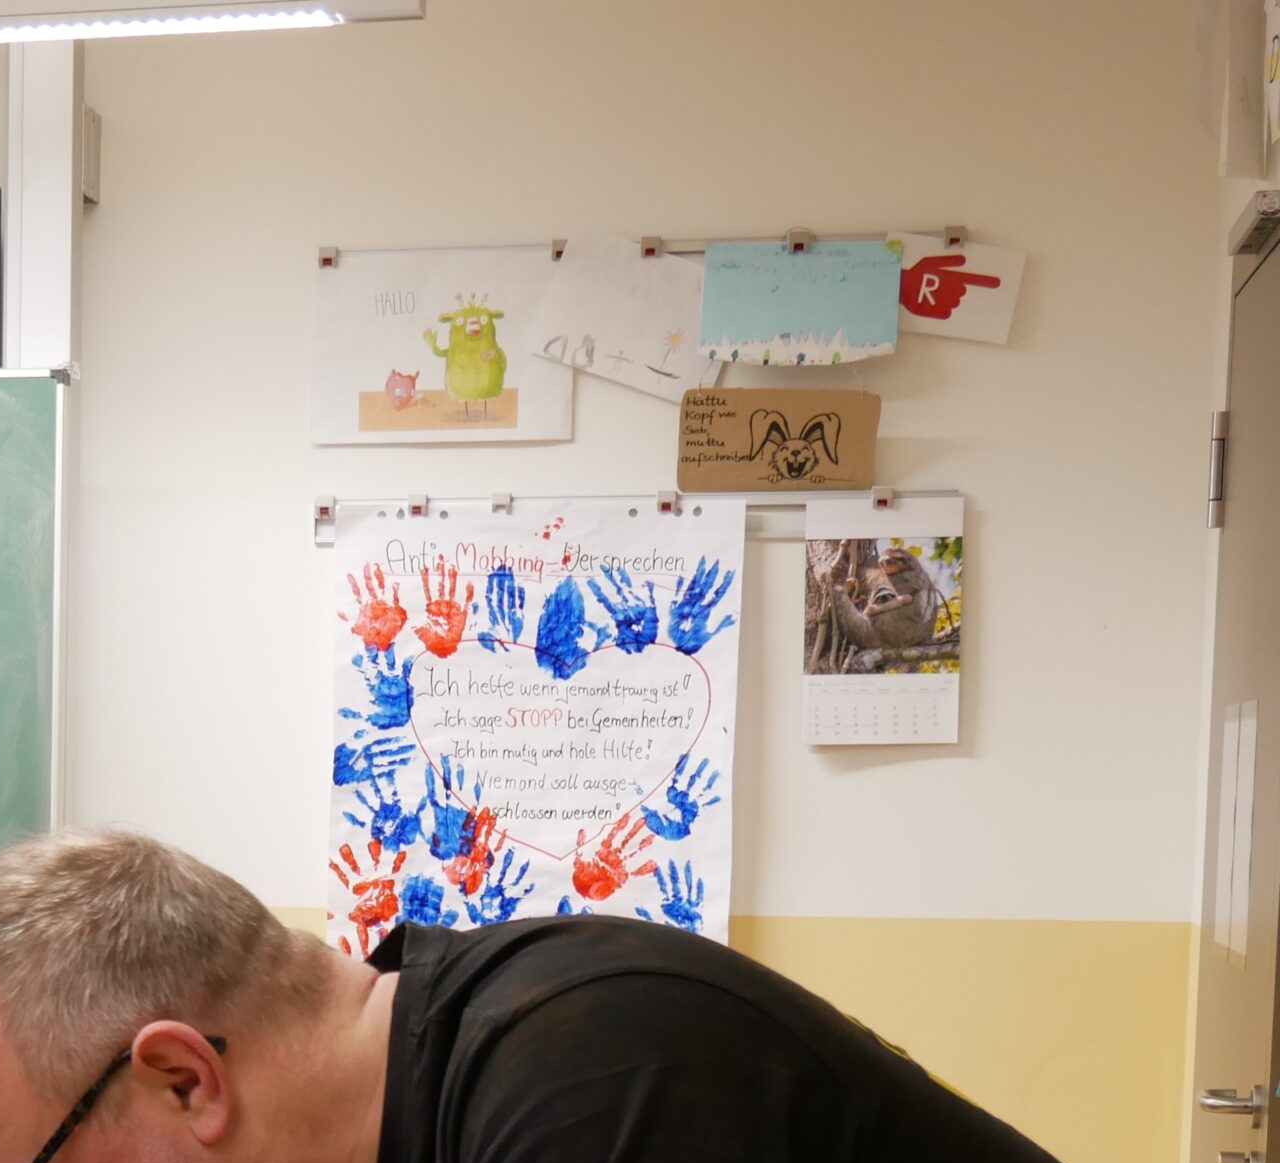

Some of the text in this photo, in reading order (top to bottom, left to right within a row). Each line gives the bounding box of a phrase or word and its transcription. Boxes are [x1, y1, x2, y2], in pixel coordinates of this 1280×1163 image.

[917, 273, 940, 306] R
[374, 290, 416, 319] HALLO
[686, 395, 727, 407] Hattu
[685, 408, 716, 425] Kopf
[416, 667, 460, 697] Ich
[519, 683, 560, 697] wenn
[555, 680, 611, 704] jemand
[433, 706, 467, 728] Ich
[470, 717, 503, 735] sage
[504, 706, 563, 729] STOPP
[567, 709, 589, 730] bei
[448, 737, 475, 759] Ich
[479, 737, 498, 759] bin
[502, 743, 538, 767] mutig
[541, 743, 564, 759] und
[569, 741, 597, 760] hole
[475, 769, 546, 791] Niemand
[551, 772, 579, 790] soll
[492, 800, 558, 820] schlossen
